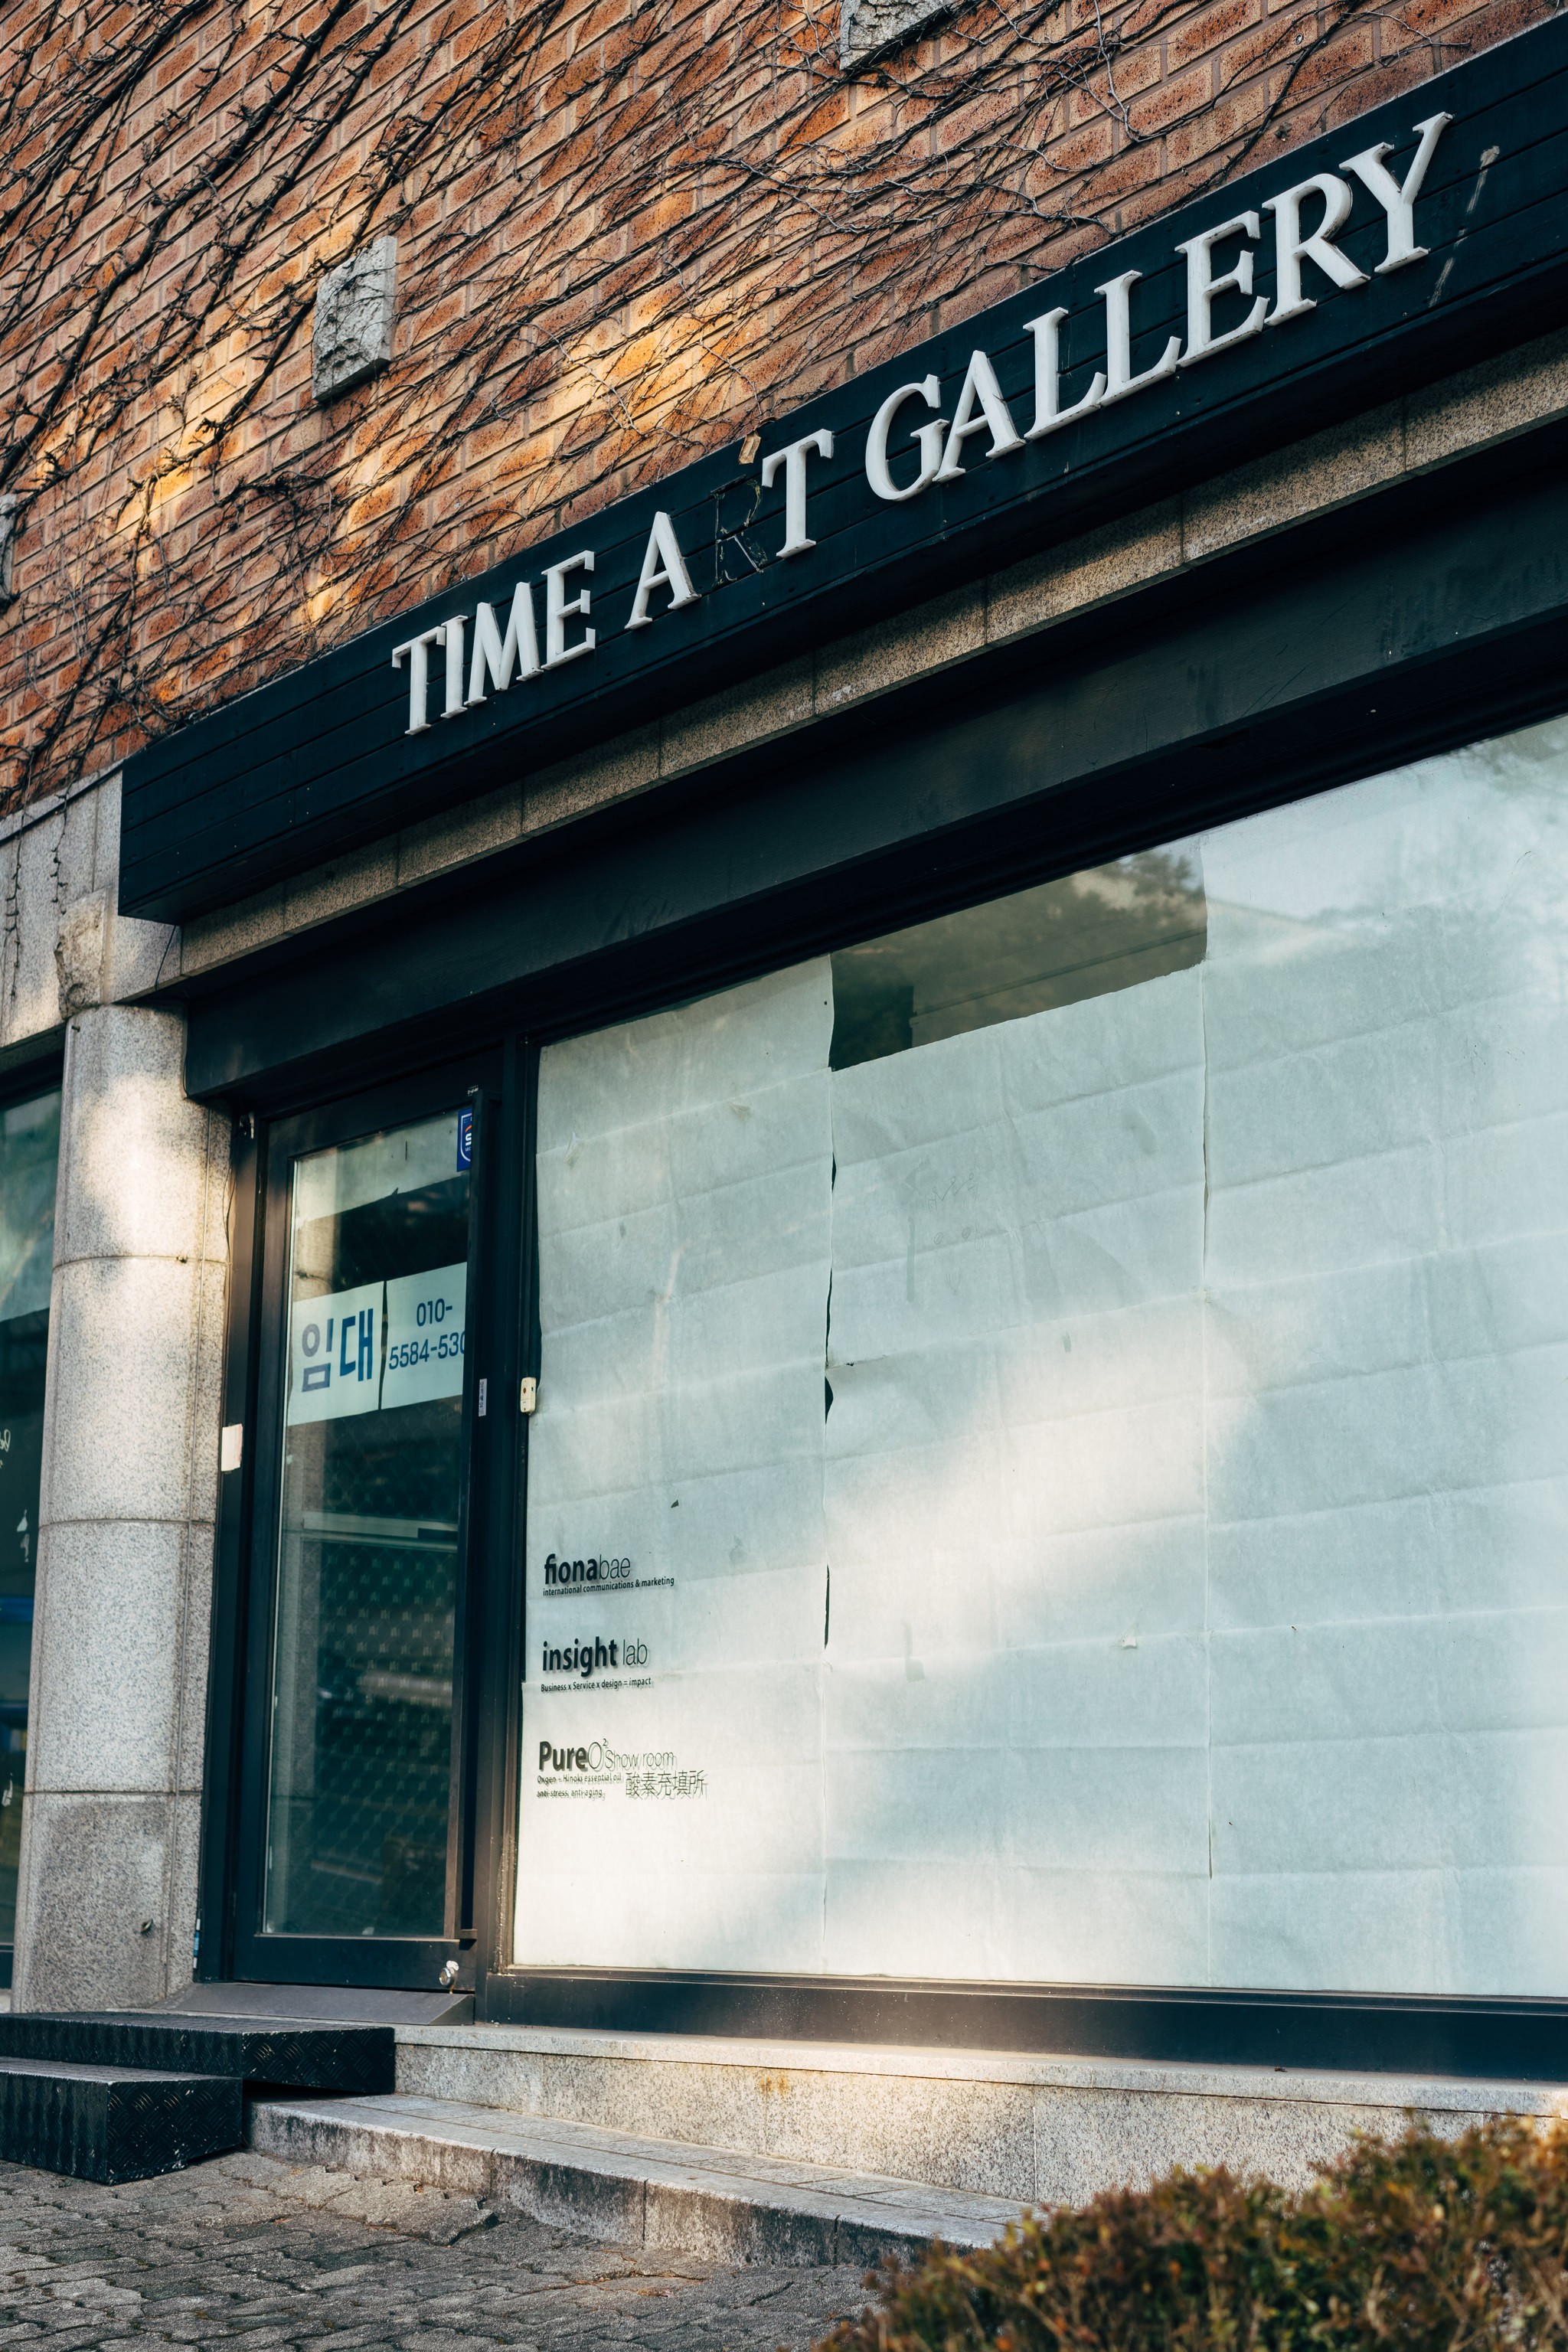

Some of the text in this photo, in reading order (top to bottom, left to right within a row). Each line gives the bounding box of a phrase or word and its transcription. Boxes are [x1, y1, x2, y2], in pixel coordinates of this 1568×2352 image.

[390, 550, 596, 737] TIME
[865, 112, 1453, 502] GALLERY
[416, 1298, 453, 1327] 010-
[302, 1308, 374, 1393] 임대
[544, 1553, 631, 1585] fionabae
[543, 1576, 675, 1596] international communications & marketing
[543, 1636, 648, 1677] insight lab
[541, 1683, 567, 1692] Business
[573, 1680, 595, 1690] Service
[601, 1678, 622, 1690] design
[629, 1677, 652, 1687] impact
[584, 1772, 612, 1782] essential
[612, 1772, 622, 1781] oil
